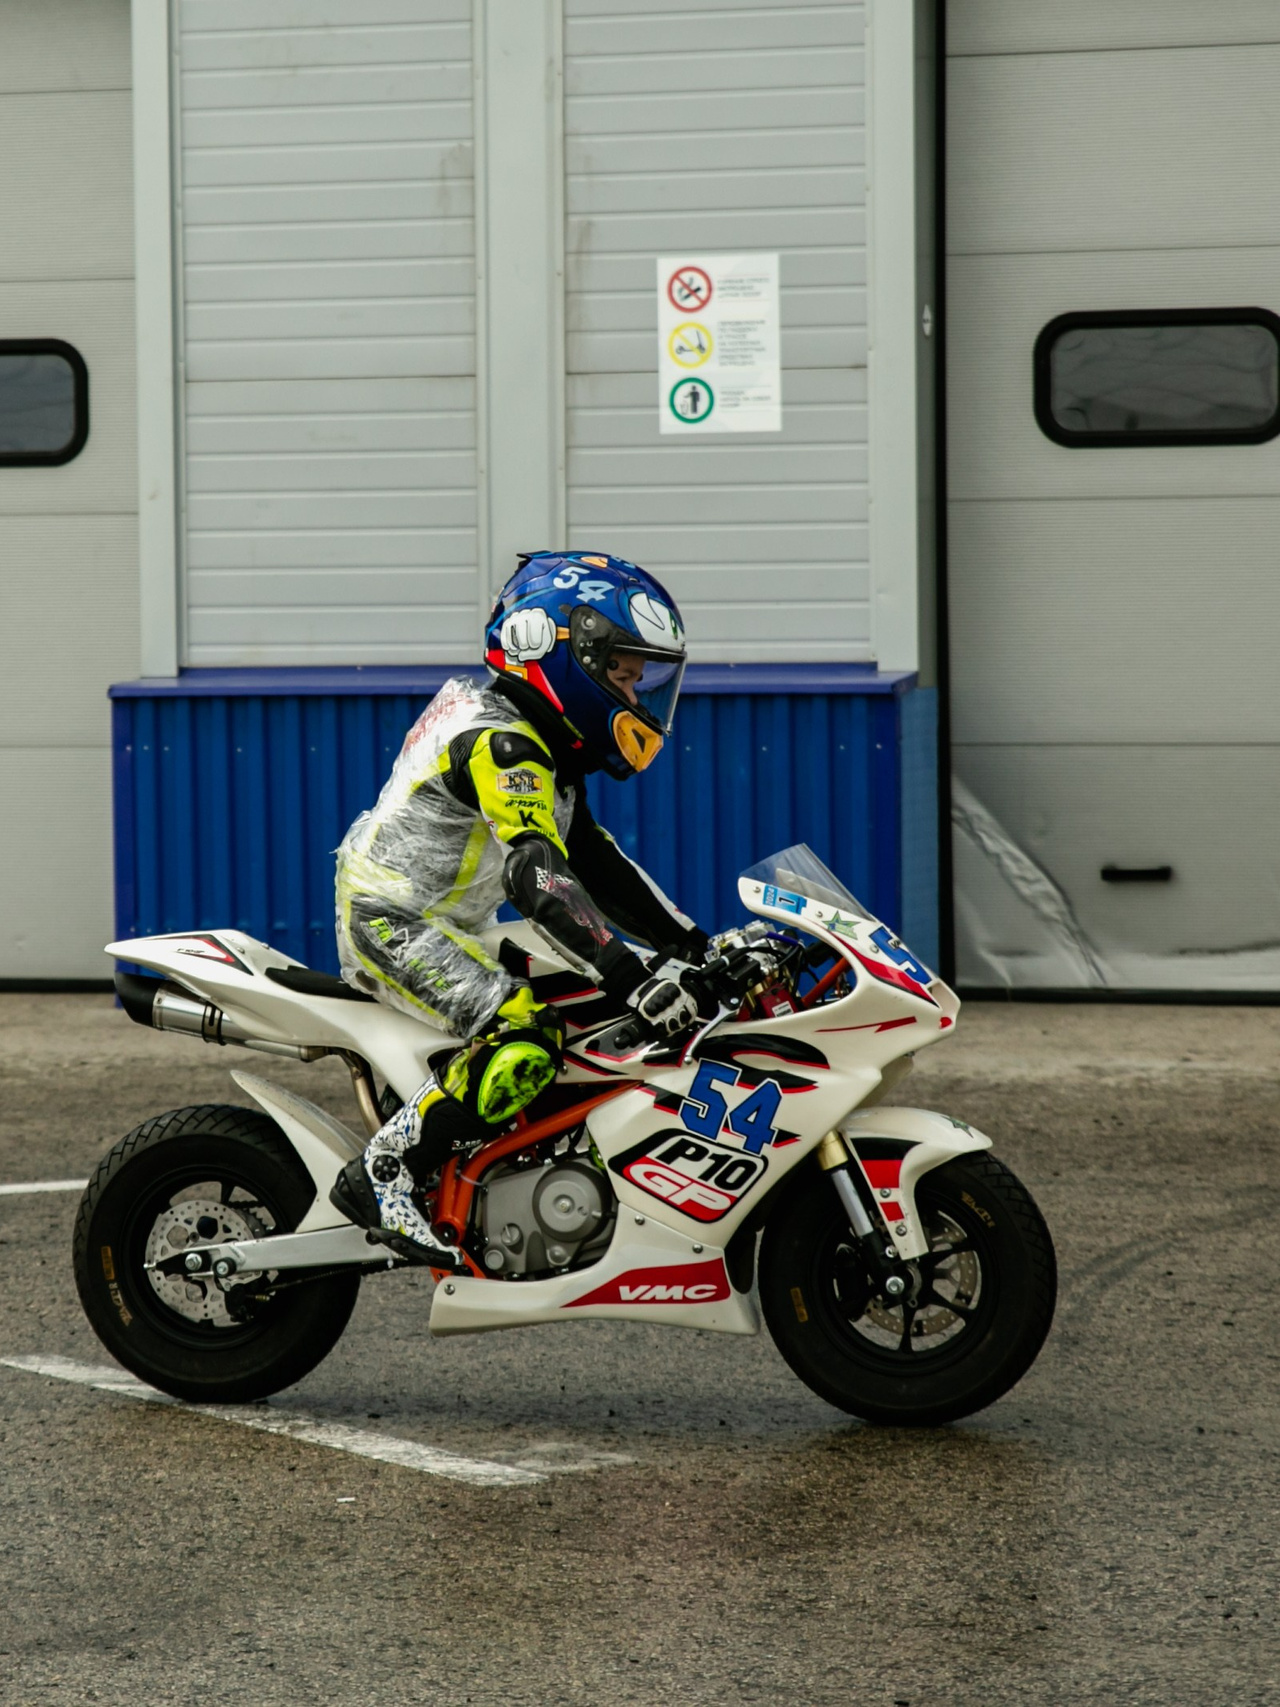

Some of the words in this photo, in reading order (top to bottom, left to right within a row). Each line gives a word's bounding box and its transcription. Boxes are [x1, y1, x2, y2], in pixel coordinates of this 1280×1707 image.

[553, 566, 615, 603] 54
[678, 1057, 783, 1157] 54
[629, 1163, 732, 1210] GP
[656, 1137, 758, 1191] P10
[618, 1284, 718, 1301] VMC
